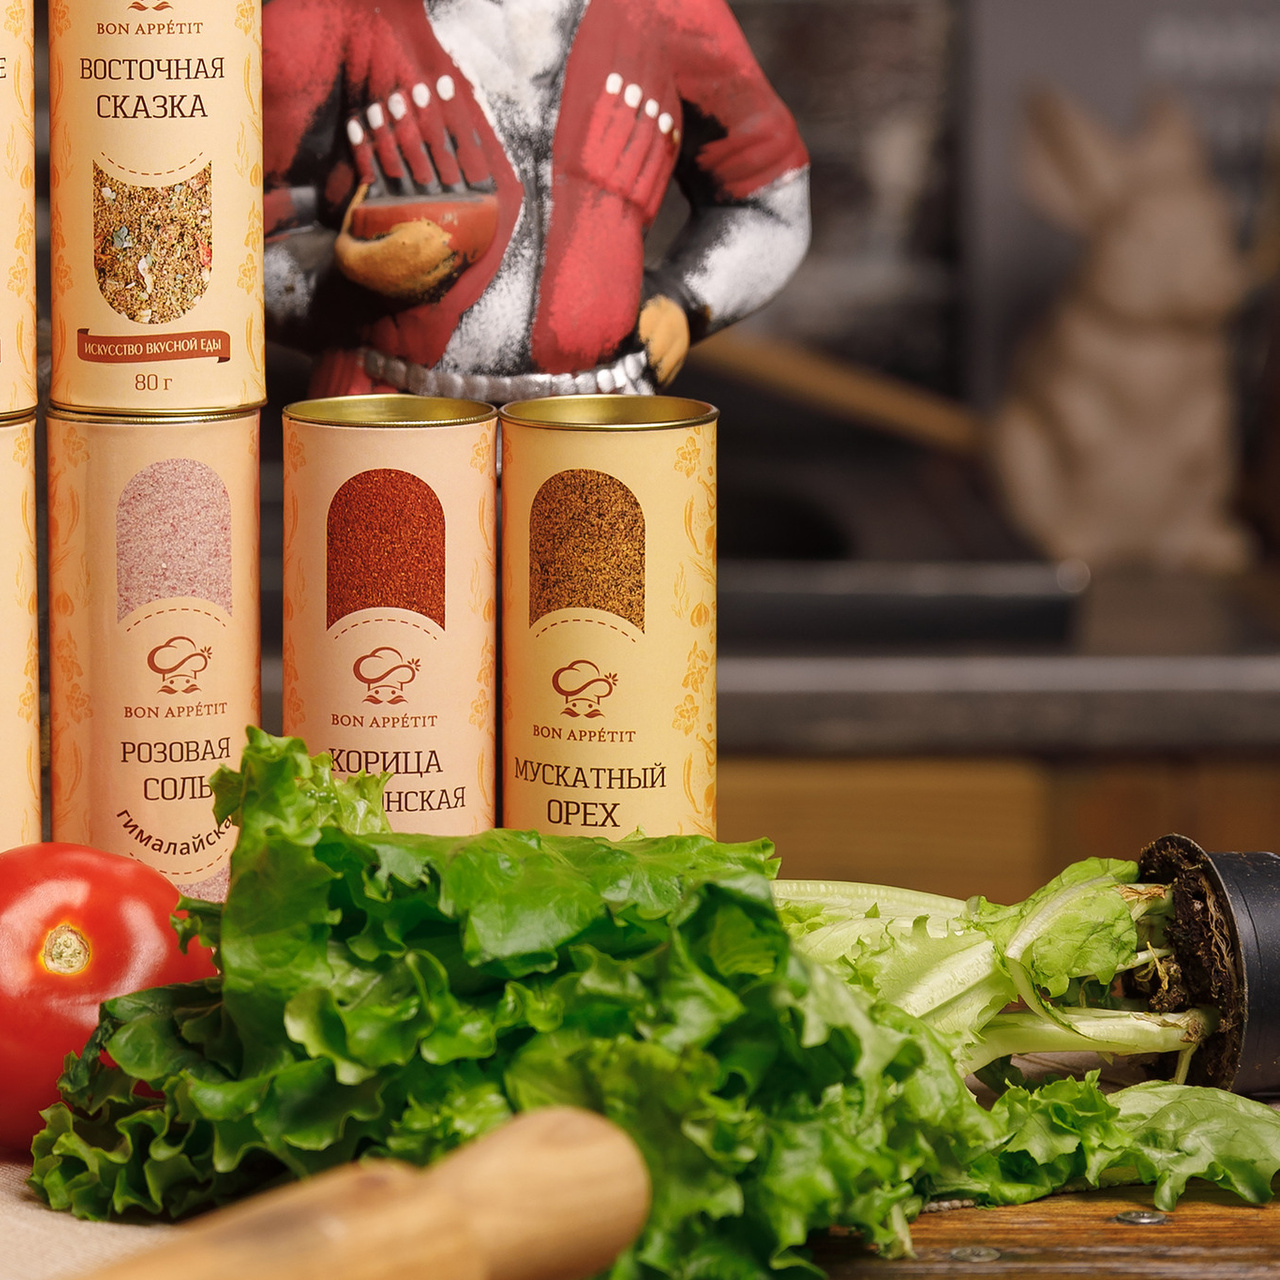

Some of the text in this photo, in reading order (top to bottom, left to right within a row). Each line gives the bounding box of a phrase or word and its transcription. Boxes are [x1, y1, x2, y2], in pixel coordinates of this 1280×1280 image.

[97, 20, 203, 34] BON APPÉTIT
[80, 57, 224, 80] ВОСТОЧНАЯ
[97, 95, 208, 118] СКАЗКА
[84, 337, 222, 356] ИСКУССТВО ВКУСНОЙ ЕДЫ
[135, 374, 172, 390] 80 г
[124, 701, 227, 718] BON APPÉTIT
[331, 713, 437, 728] BON APPÉTIT
[533, 725, 636, 742] BON APPÉTIT
[121, 737, 231, 763] РОЗОВАЯ
[329, 748, 443, 778] КОРИЦА
[515, 758, 666, 789] МУСКАТНЫЙ
[143, 775, 213, 801] СОЛЬ
[548, 799, 620, 827] ОРЕХ
[117, 809, 232, 856] гималайска
